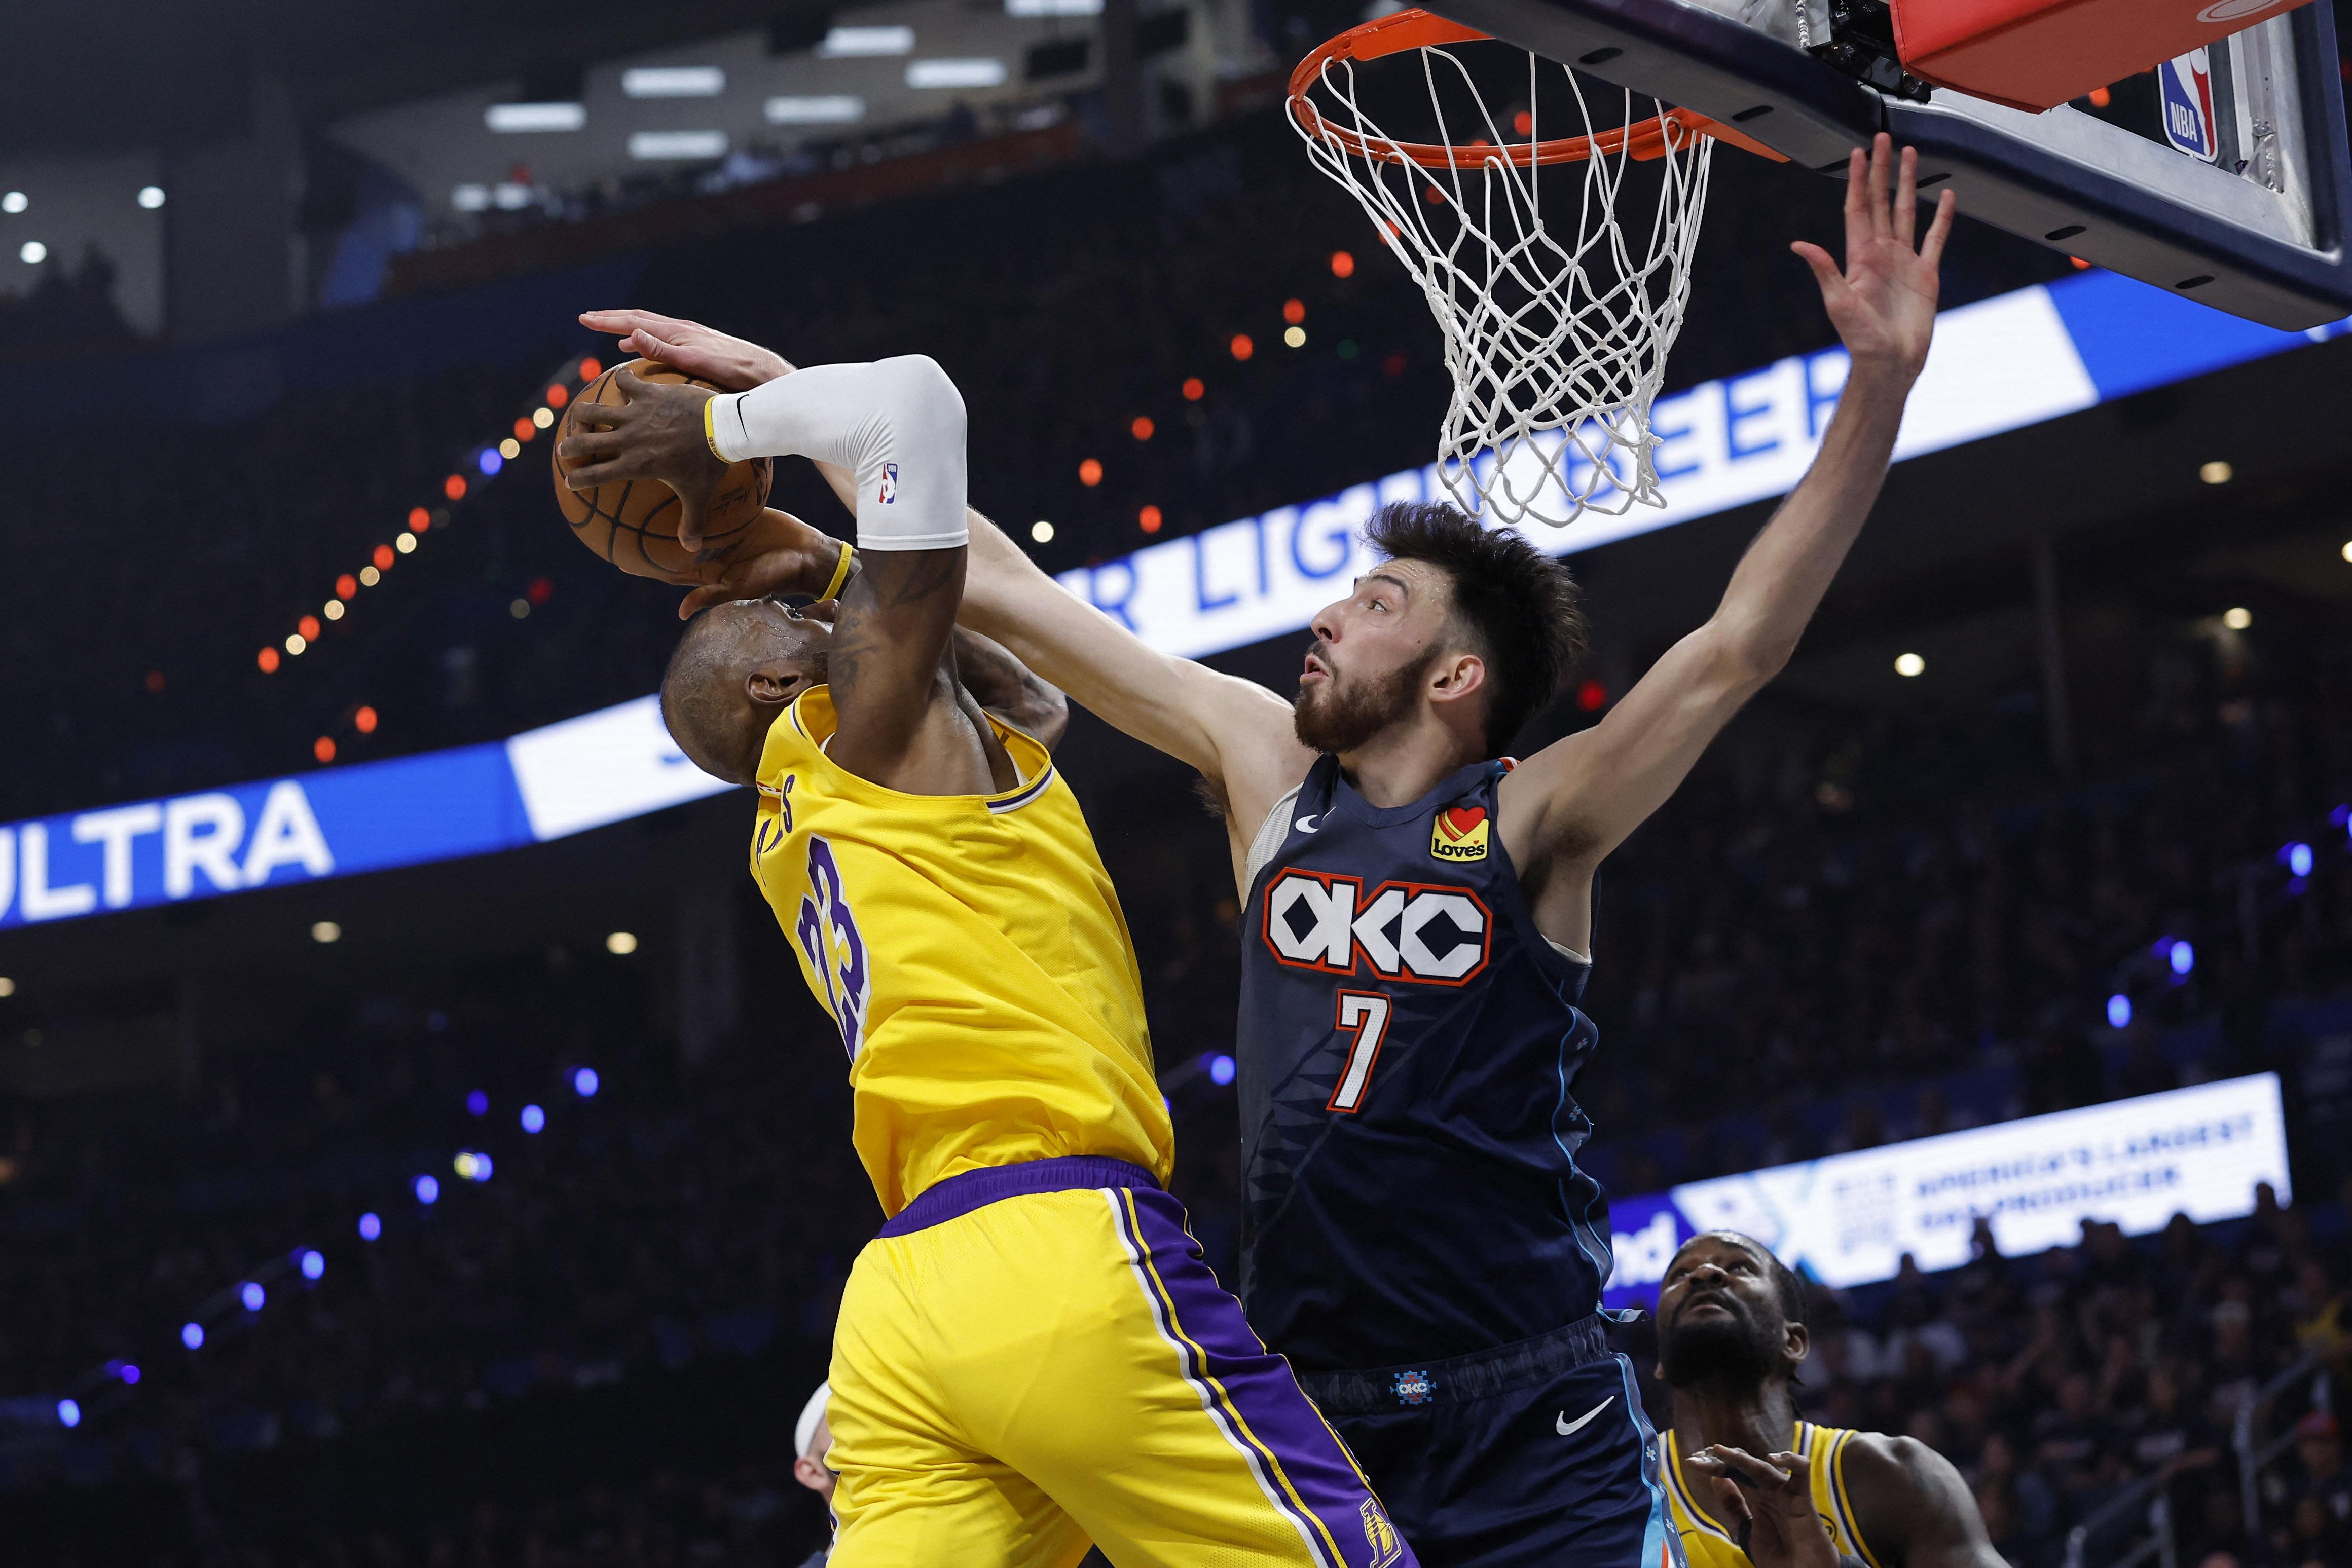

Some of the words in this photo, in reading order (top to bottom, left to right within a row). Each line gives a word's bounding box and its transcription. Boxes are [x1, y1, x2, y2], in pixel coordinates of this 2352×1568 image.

[2170, 101, 2198, 143] NBA
[1262, 867, 1492, 987] OKC
[1326, 988, 1391, 1113] 7
[1399, 1382, 1428, 1394] OKC
